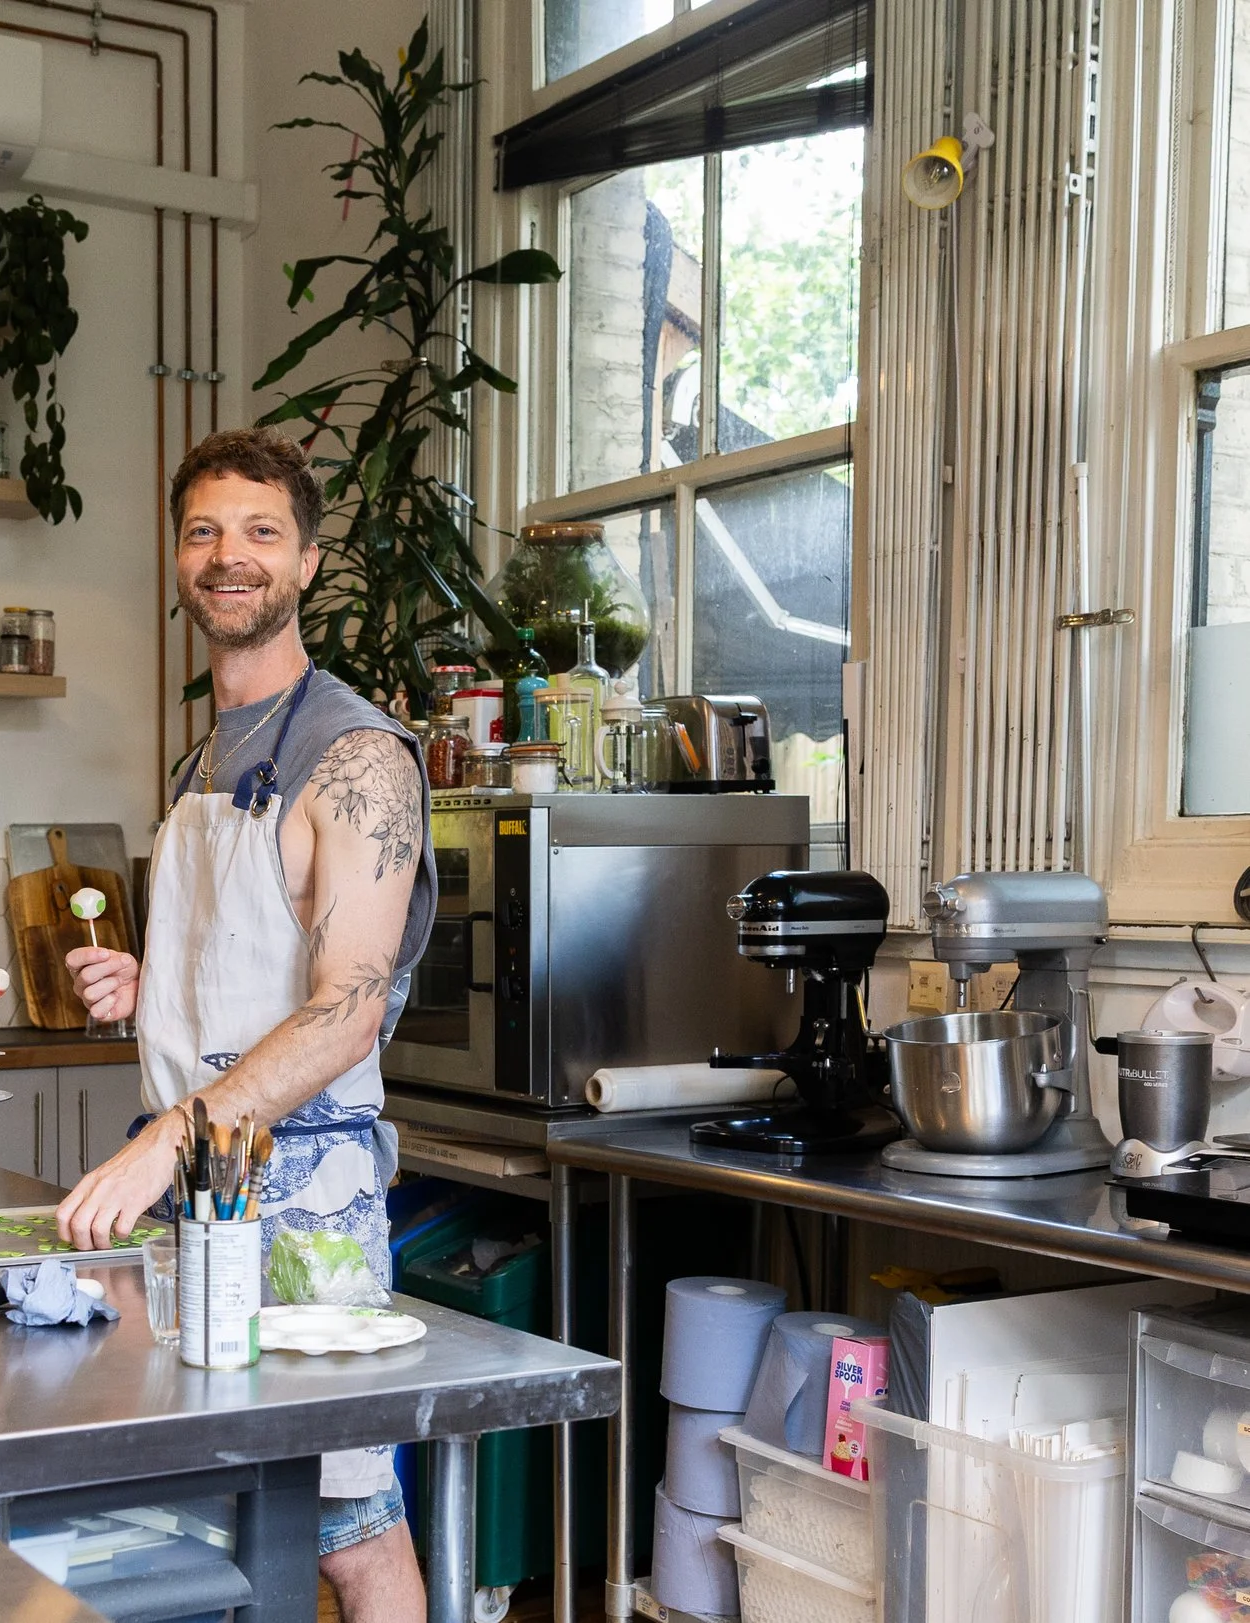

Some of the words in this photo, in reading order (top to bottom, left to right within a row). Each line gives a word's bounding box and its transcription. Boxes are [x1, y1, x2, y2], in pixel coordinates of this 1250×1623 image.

[738, 923, 780, 932] chenAid
[1118, 1067, 1169, 1080] UTRiBULLET
[836, 1361, 863, 1375] SILVER
[835, 1370, 863, 1384] SPOON
